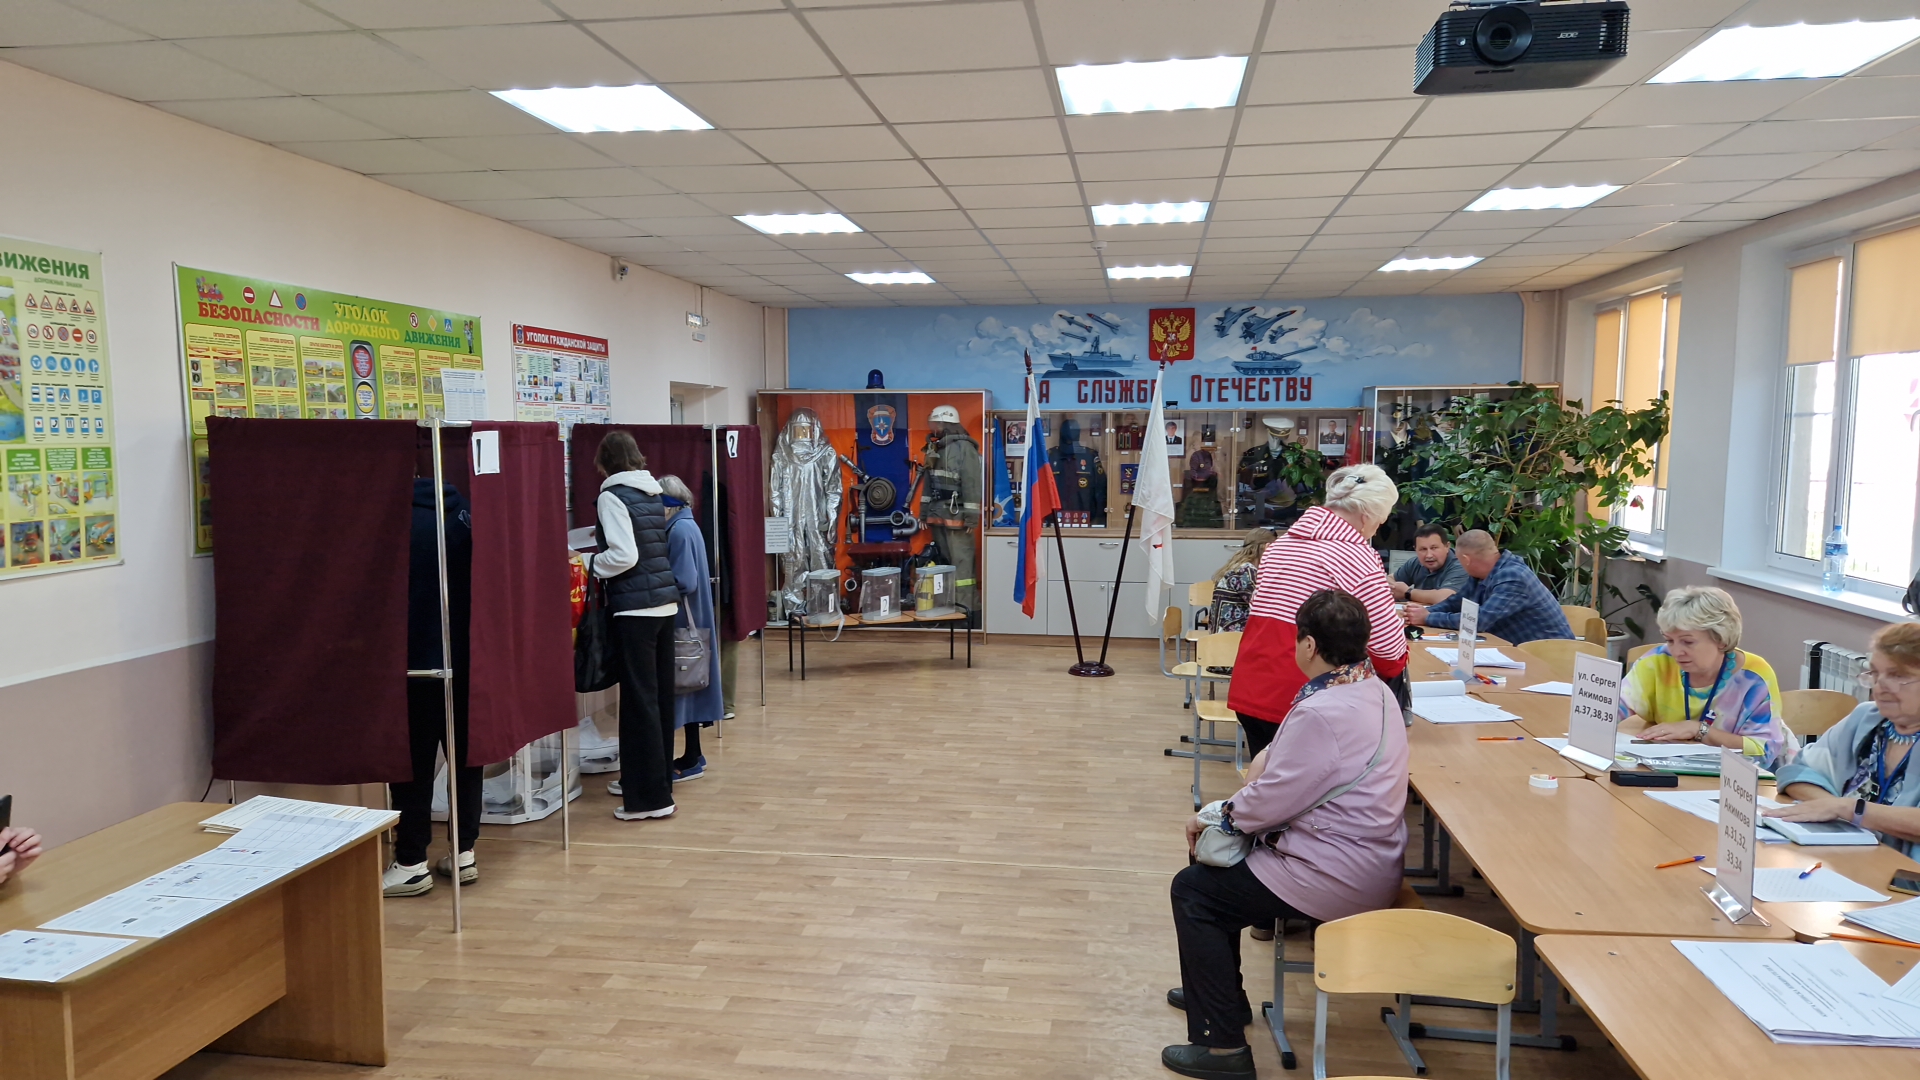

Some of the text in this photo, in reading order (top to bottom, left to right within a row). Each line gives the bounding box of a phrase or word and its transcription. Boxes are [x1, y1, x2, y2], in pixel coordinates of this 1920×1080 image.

[1556, 31, 1579, 39] acer
[333, 301, 390, 325] УГОЛОК
[197, 301, 462, 349] БЕЗОПАСНОСТИ ДОРОЖНОГО ДВИЖЕНИЯ
[526, 331, 550, 344] УГОЛОК
[550, 336, 587, 350] ГРАЖДАНСКОЙ
[587, 340, 606, 353] ЗАЩИТЫ
[1190, 374, 1313, 403] ОТЕЧЕСТВУ
[729, 435, 736, 457] 2
[937, 582, 942, 591] 3
[882, 598, 888, 613] 2
[1577, 671, 1617, 690] ул. Сергея
[1578, 687, 1613, 706] Акимова
[1574, 704, 1614, 723] д.37,38,39
[1723, 775, 1753, 805] ул. Сергея
[1724, 797, 1751, 828] Акимова
[1724, 824, 1748, 853] д.31,32,
[1726, 849, 1743, 873] 33,34
